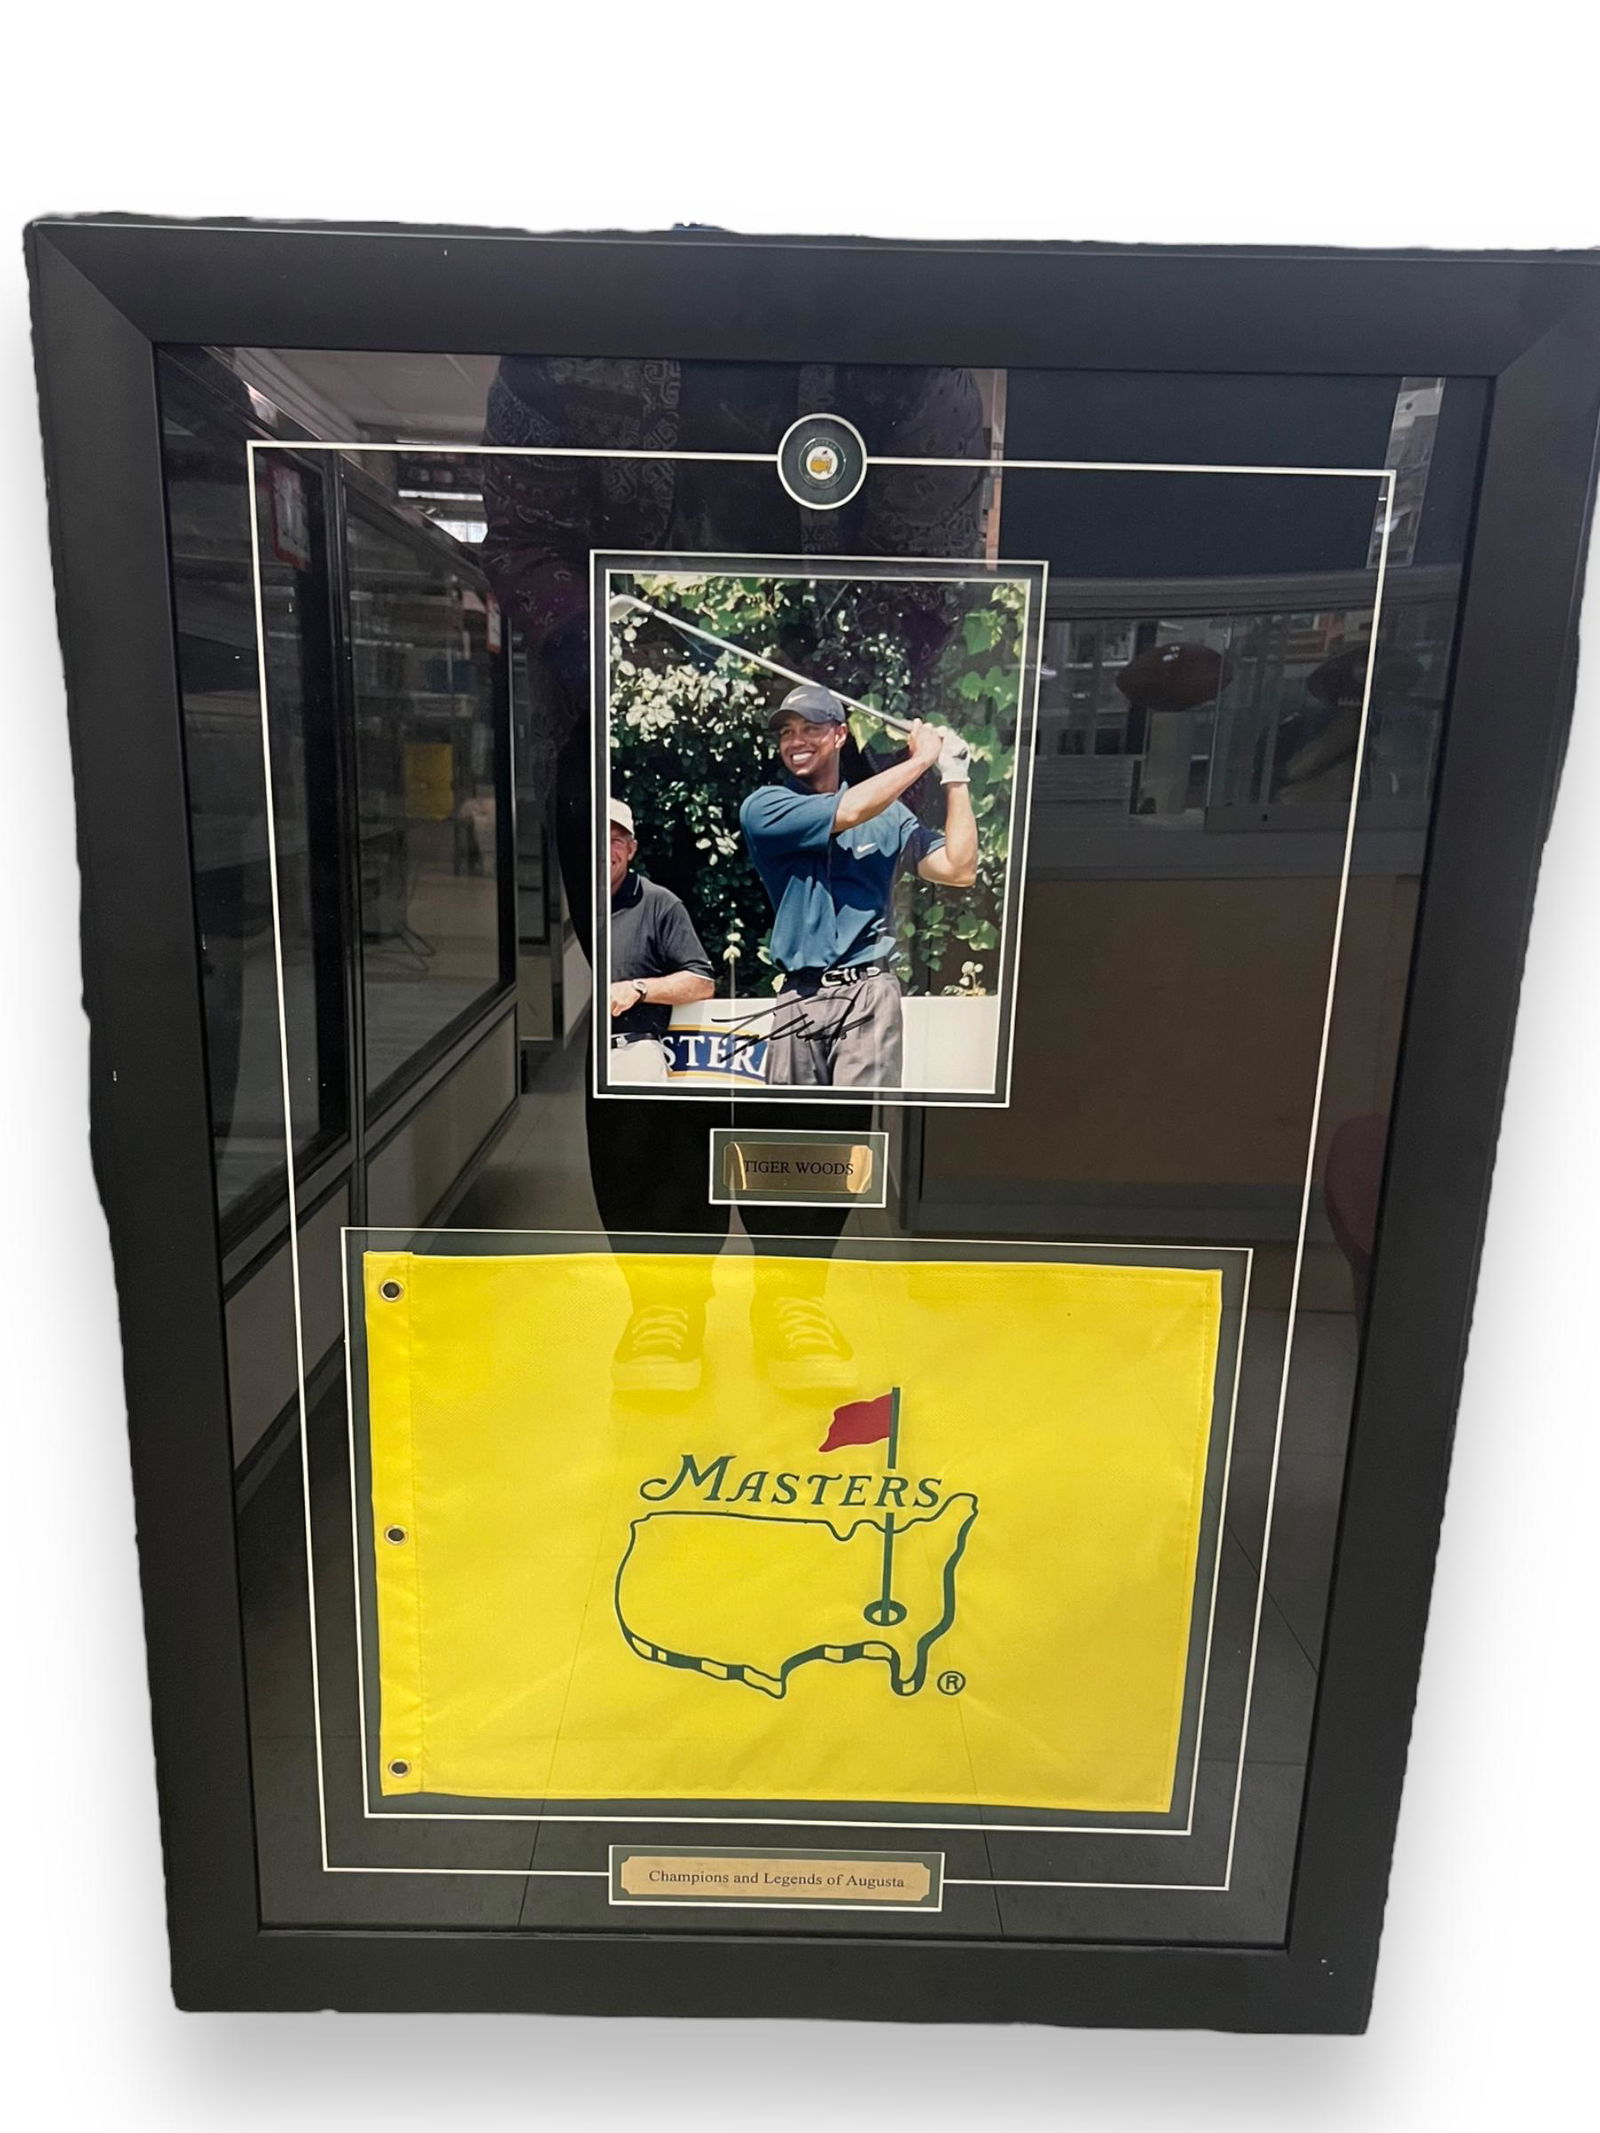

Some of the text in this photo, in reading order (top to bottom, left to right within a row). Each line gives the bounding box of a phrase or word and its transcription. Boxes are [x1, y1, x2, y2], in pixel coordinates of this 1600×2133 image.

[662, 1034, 769, 1078] STER
[744, 1160, 854, 1175] TIGER WOODS
[639, 1453, 943, 1508] MASTERS
[648, 1869, 905, 1889] Champions and Legends of Augusta
